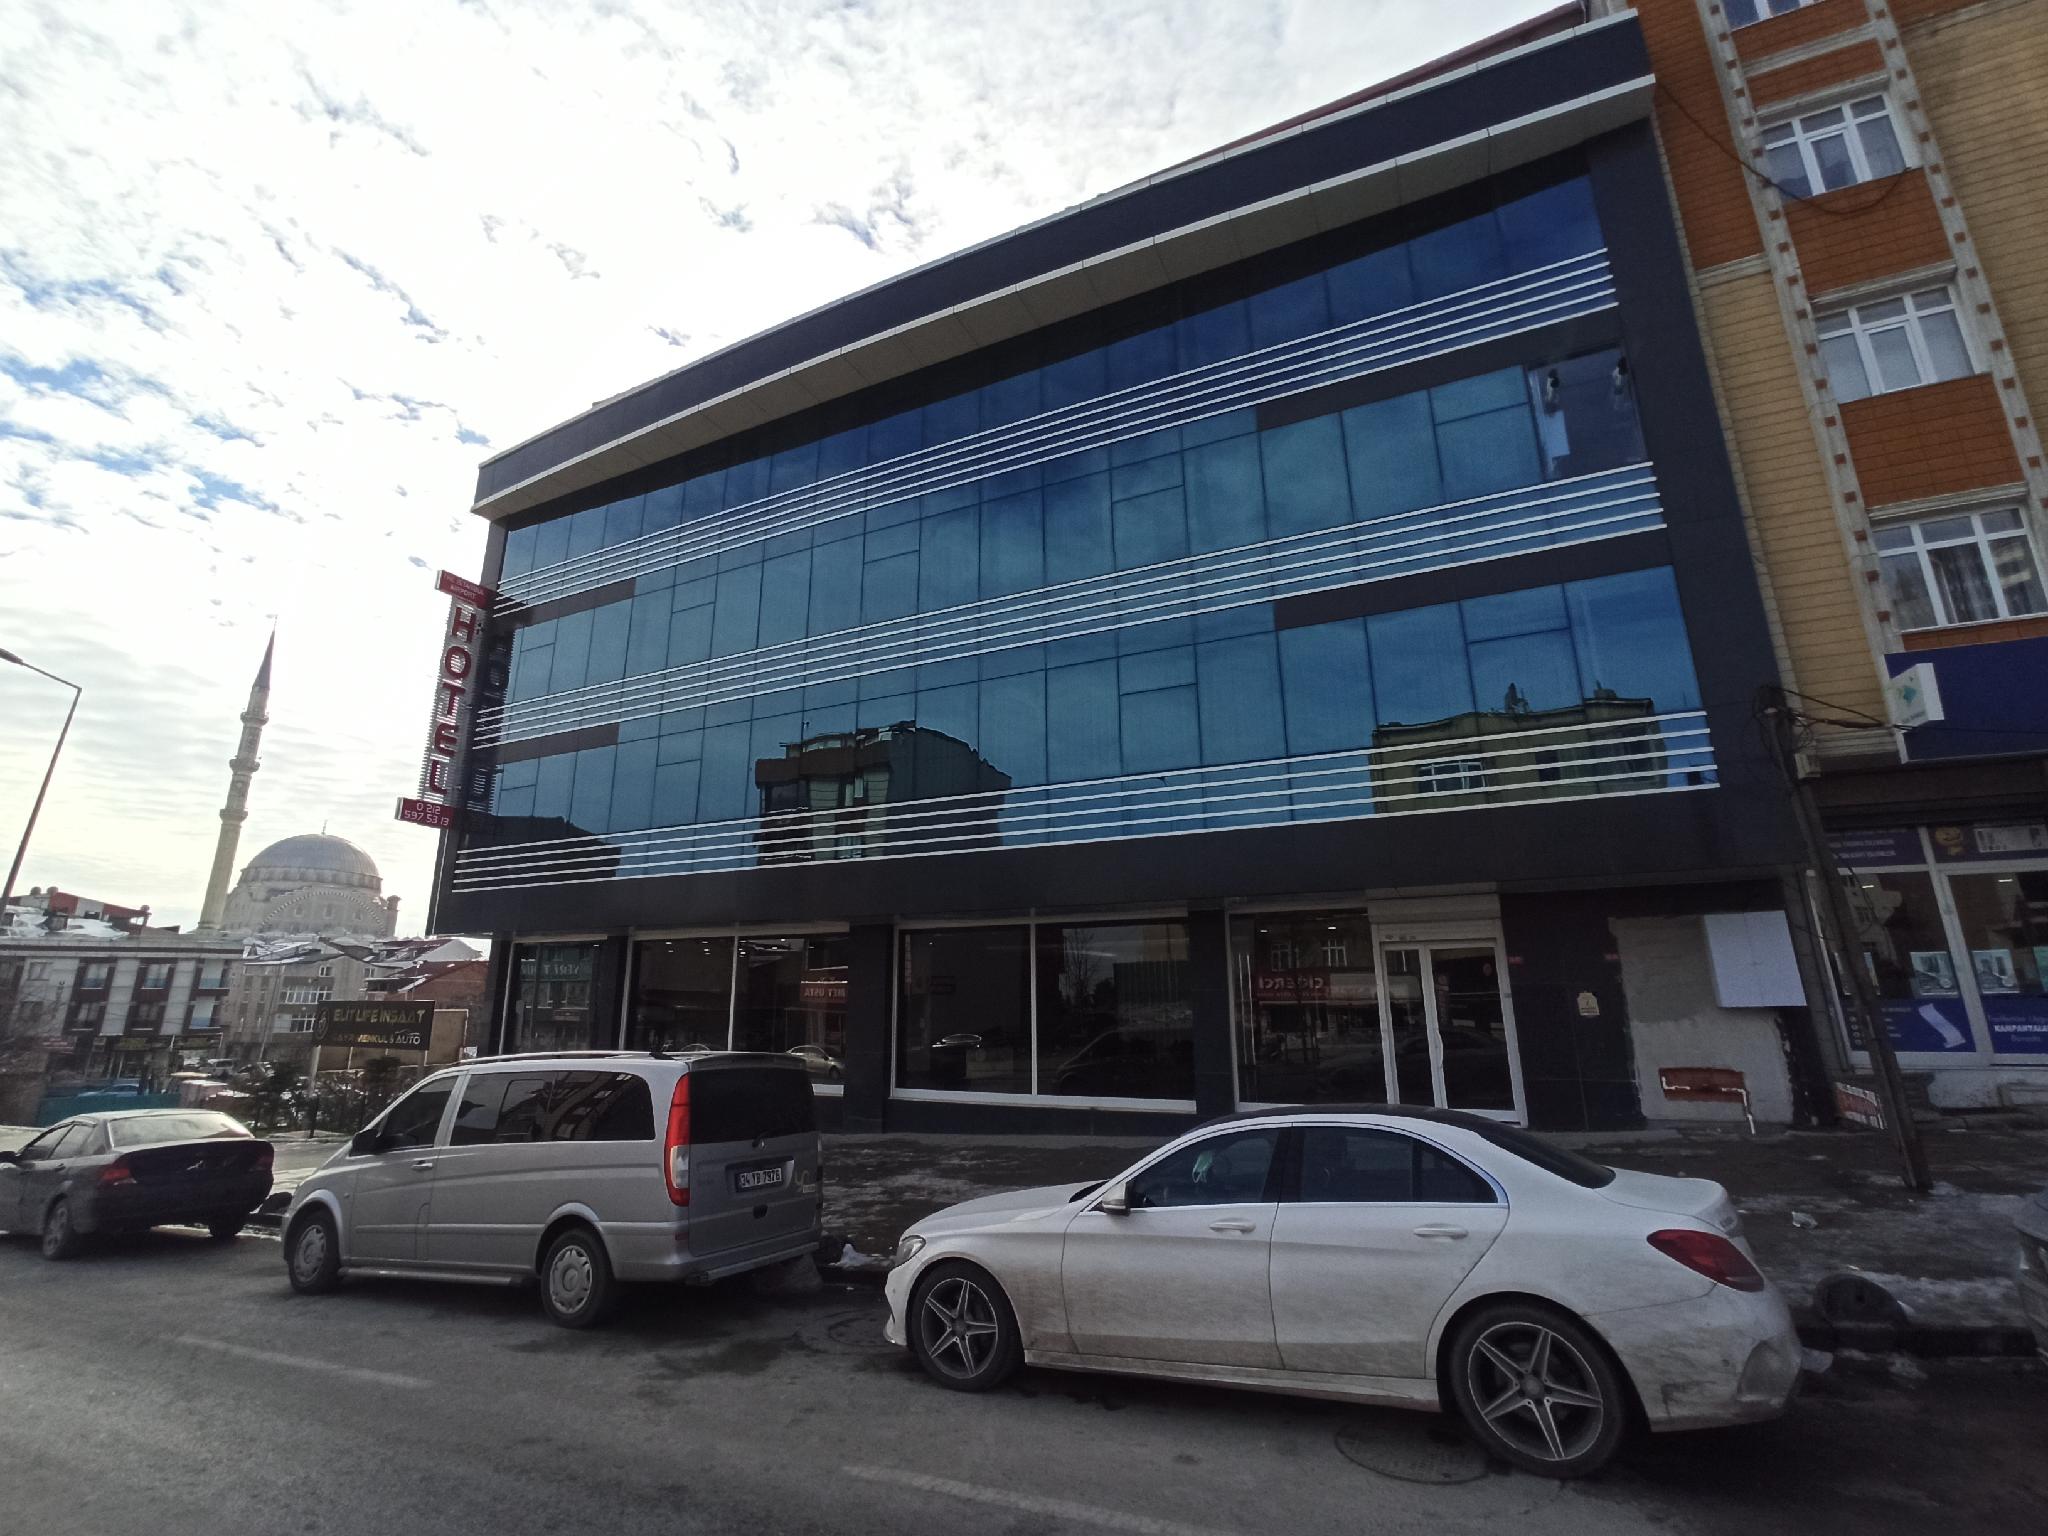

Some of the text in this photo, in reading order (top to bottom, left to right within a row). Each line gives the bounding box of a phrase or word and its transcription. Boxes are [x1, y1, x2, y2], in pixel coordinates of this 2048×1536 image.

[430, 606, 476, 795] HOTEL
[416, 802, 441, 815] 0 212
[404, 810, 450, 826] 597 53 13
[395, 1034, 421, 1045] AUTO
[741, 1173, 751, 1186] 34
